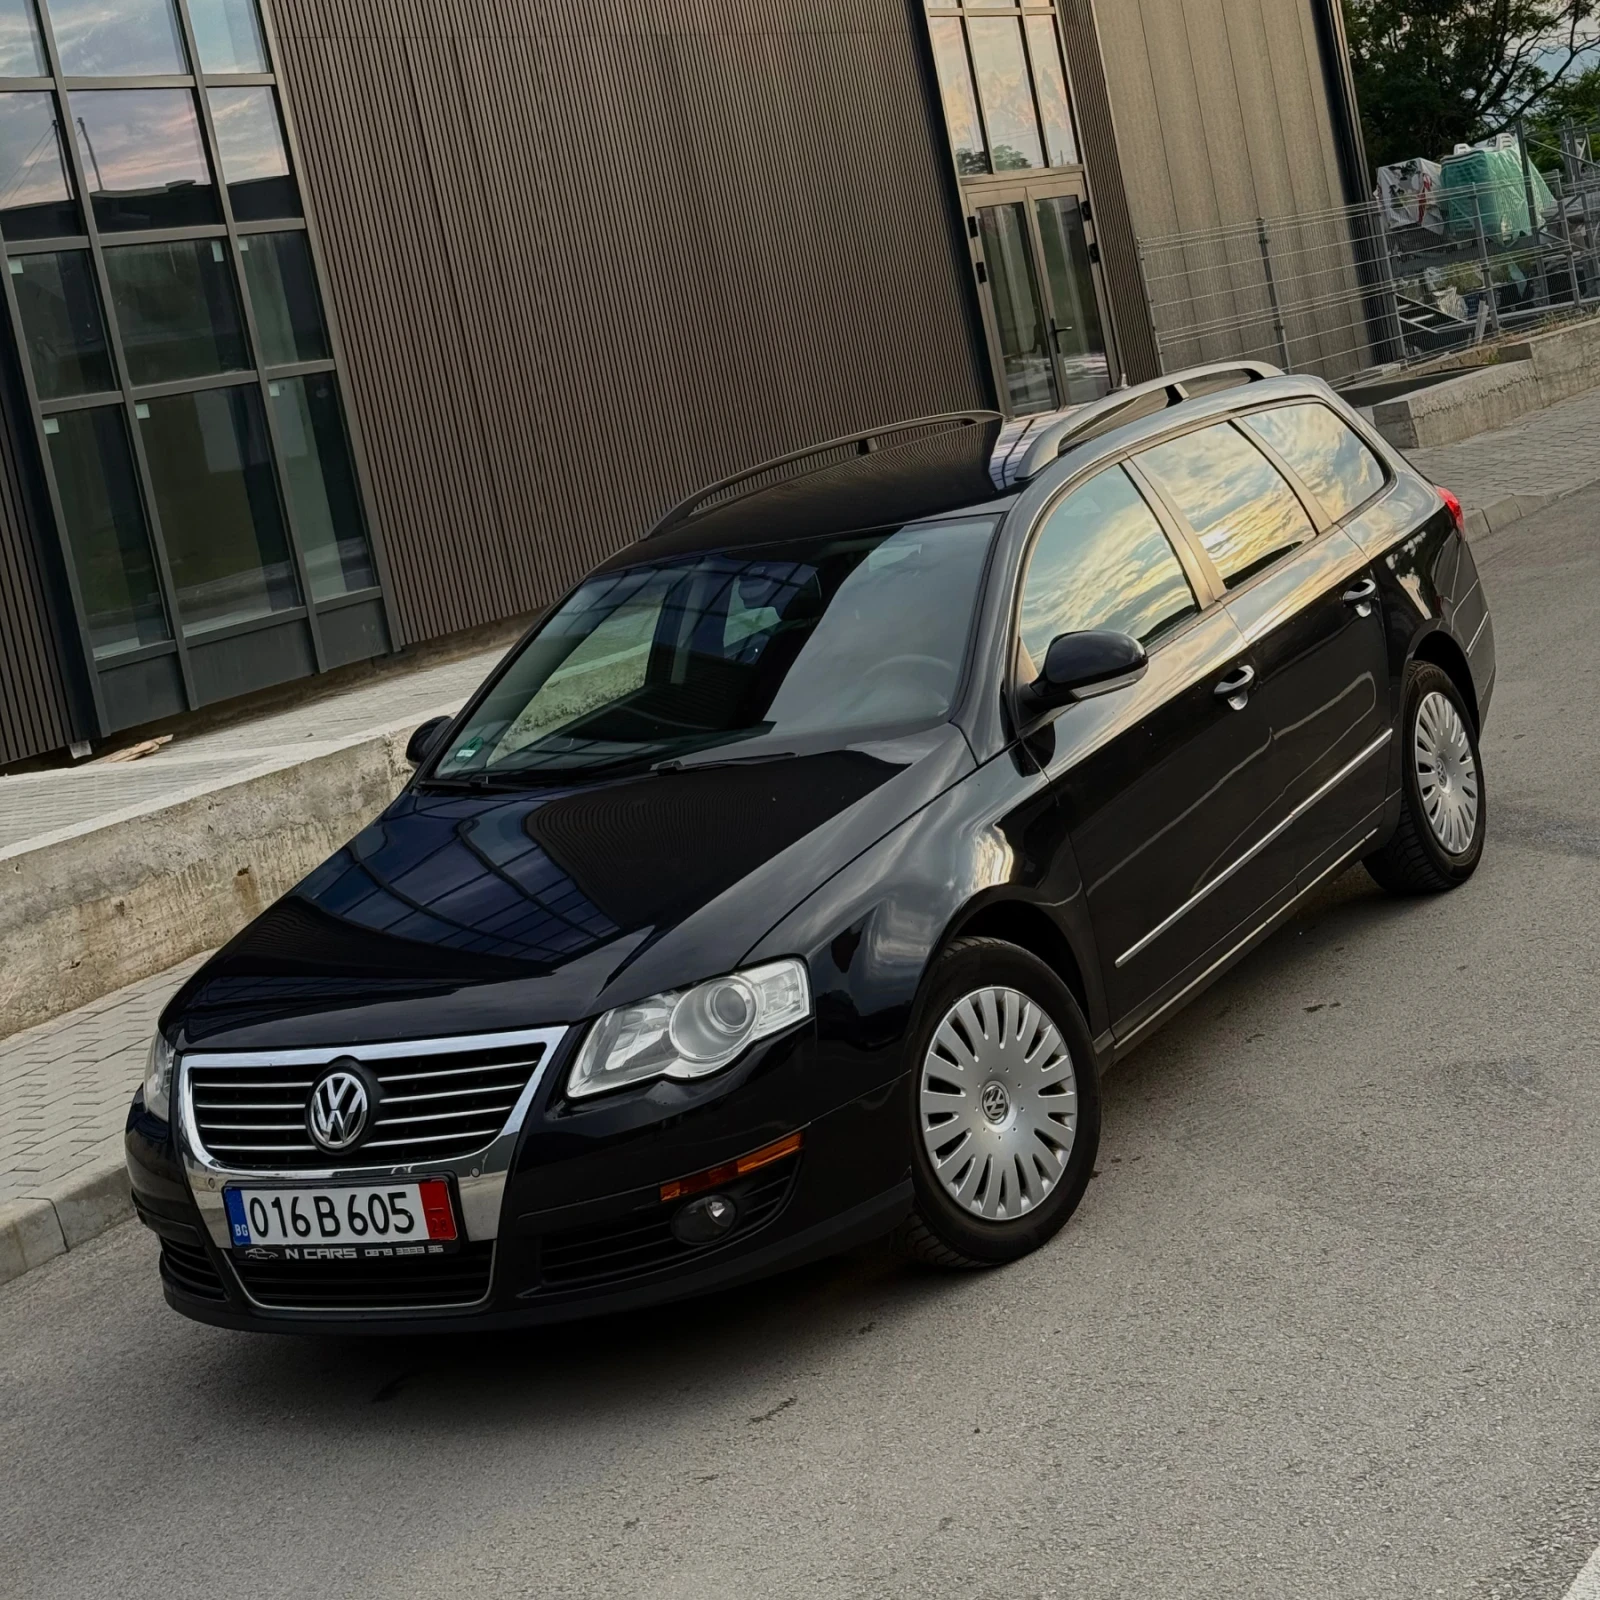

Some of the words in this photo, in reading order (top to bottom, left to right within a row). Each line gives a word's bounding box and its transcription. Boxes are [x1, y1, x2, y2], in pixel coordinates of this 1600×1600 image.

[311, 1073, 368, 1149] VW
[234, 1223, 249, 1237] BG
[285, 1248, 300, 1260] N
[303, 1247, 358, 1260] CARS
